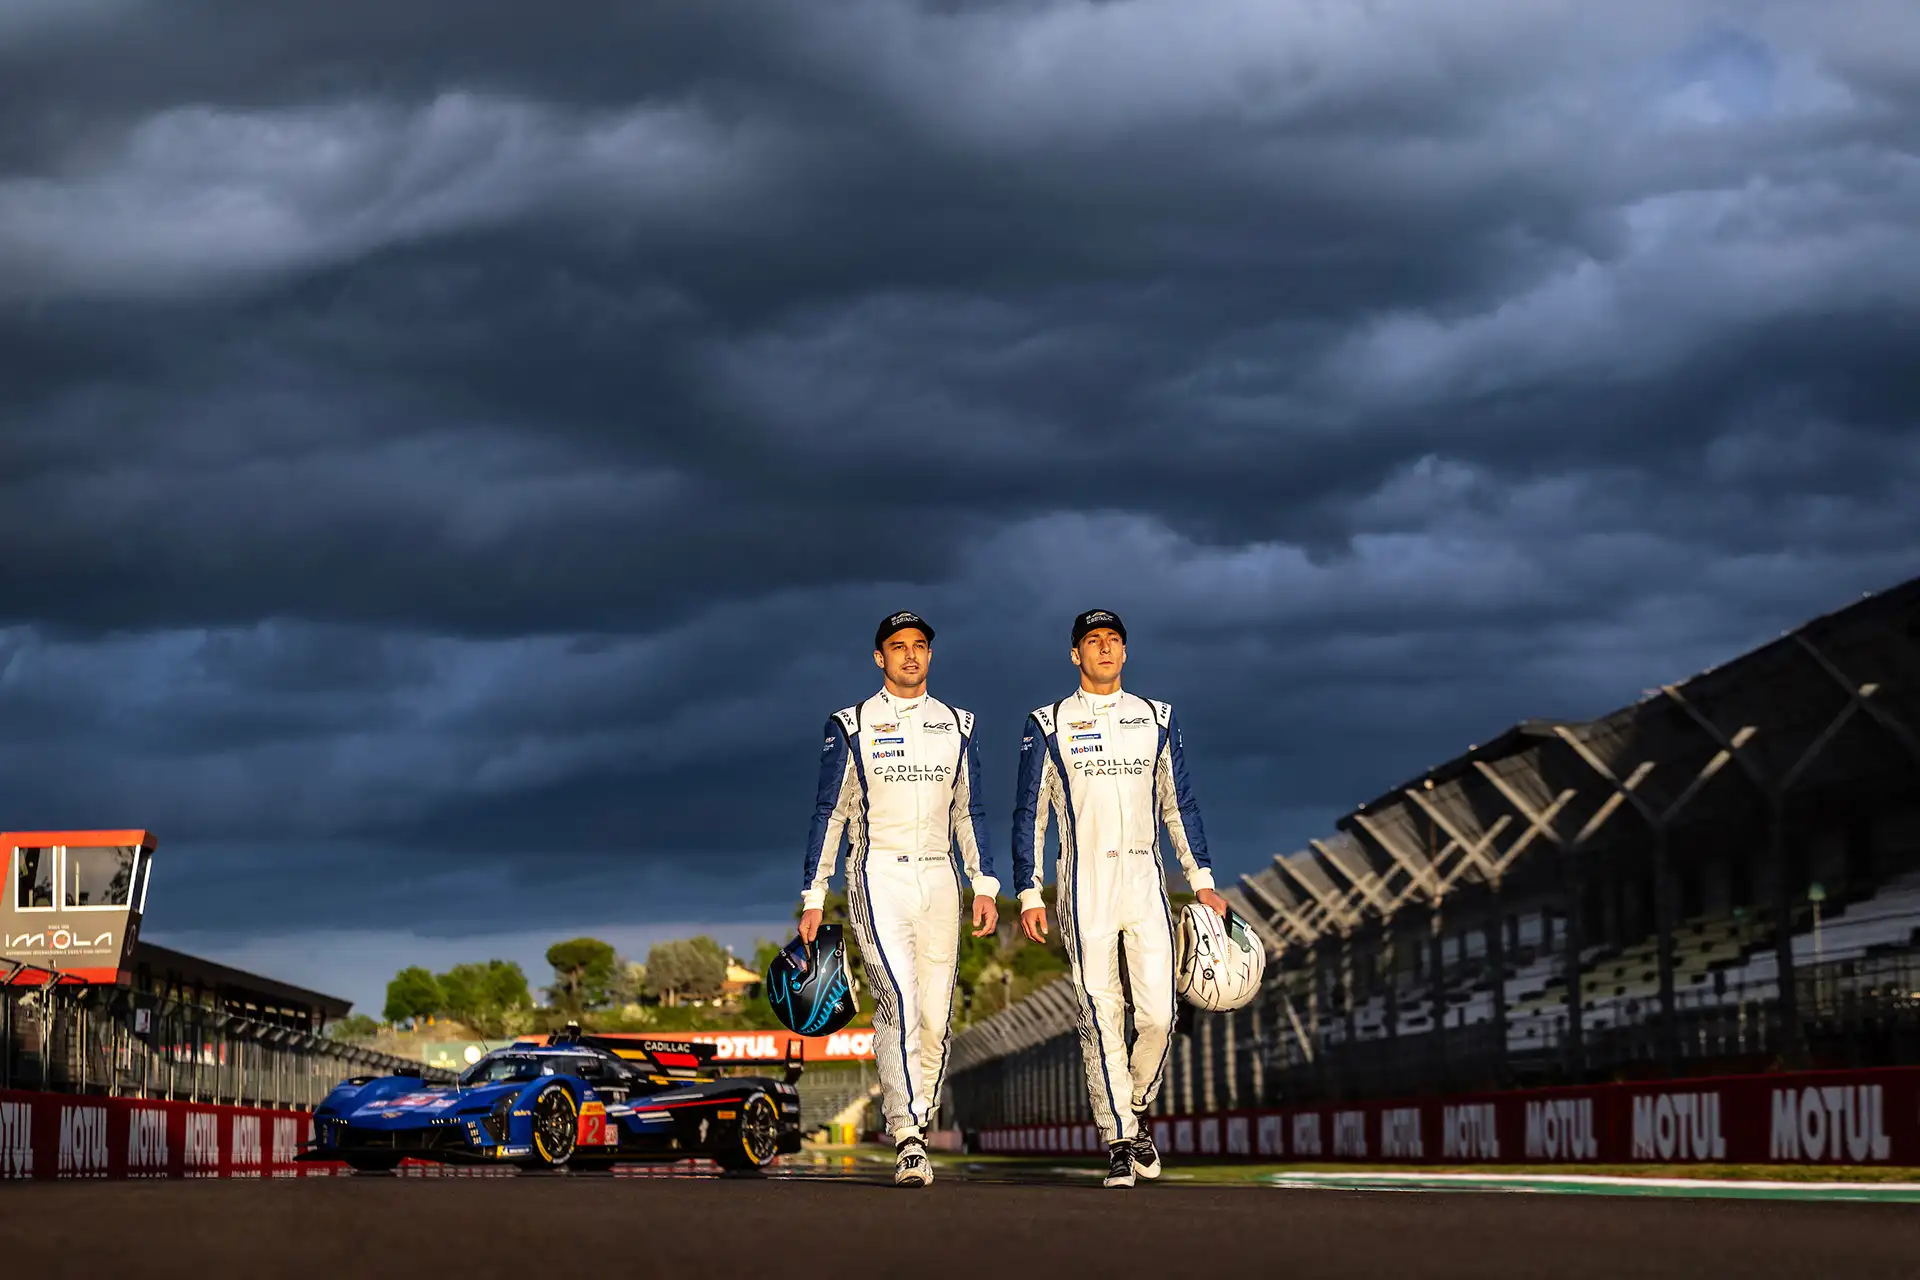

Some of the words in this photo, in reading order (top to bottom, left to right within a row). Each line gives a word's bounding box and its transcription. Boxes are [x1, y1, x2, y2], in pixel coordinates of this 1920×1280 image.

[923, 721, 954, 731] WEC
[1119, 717, 1150, 726] WEC
[872, 750, 895, 760] Mobil
[1070, 745, 1094, 755] Mobil
[873, 764, 951, 775] CADILLAC
[1073, 758, 1150, 770] CADILLAC
[1084, 767, 1143, 777] RACING
[884, 774, 944, 783] RACING
[644, 1040, 691, 1053] CADILLAC
[585, 1117, 600, 1143] 2
[1443, 1104, 1500, 1158] MOTUL
[1525, 1098, 1597, 1159] MOTUL
[1632, 1093, 1726, 1160] MOTUL
[1770, 1085, 1890, 1161] MOTUL
[58, 1105, 108, 1170] MOTUL
[128, 1108, 168, 1167] MOTUL
[184, 1111, 219, 1166] MOTUL
[231, 1114, 262, 1165] MOTUL
